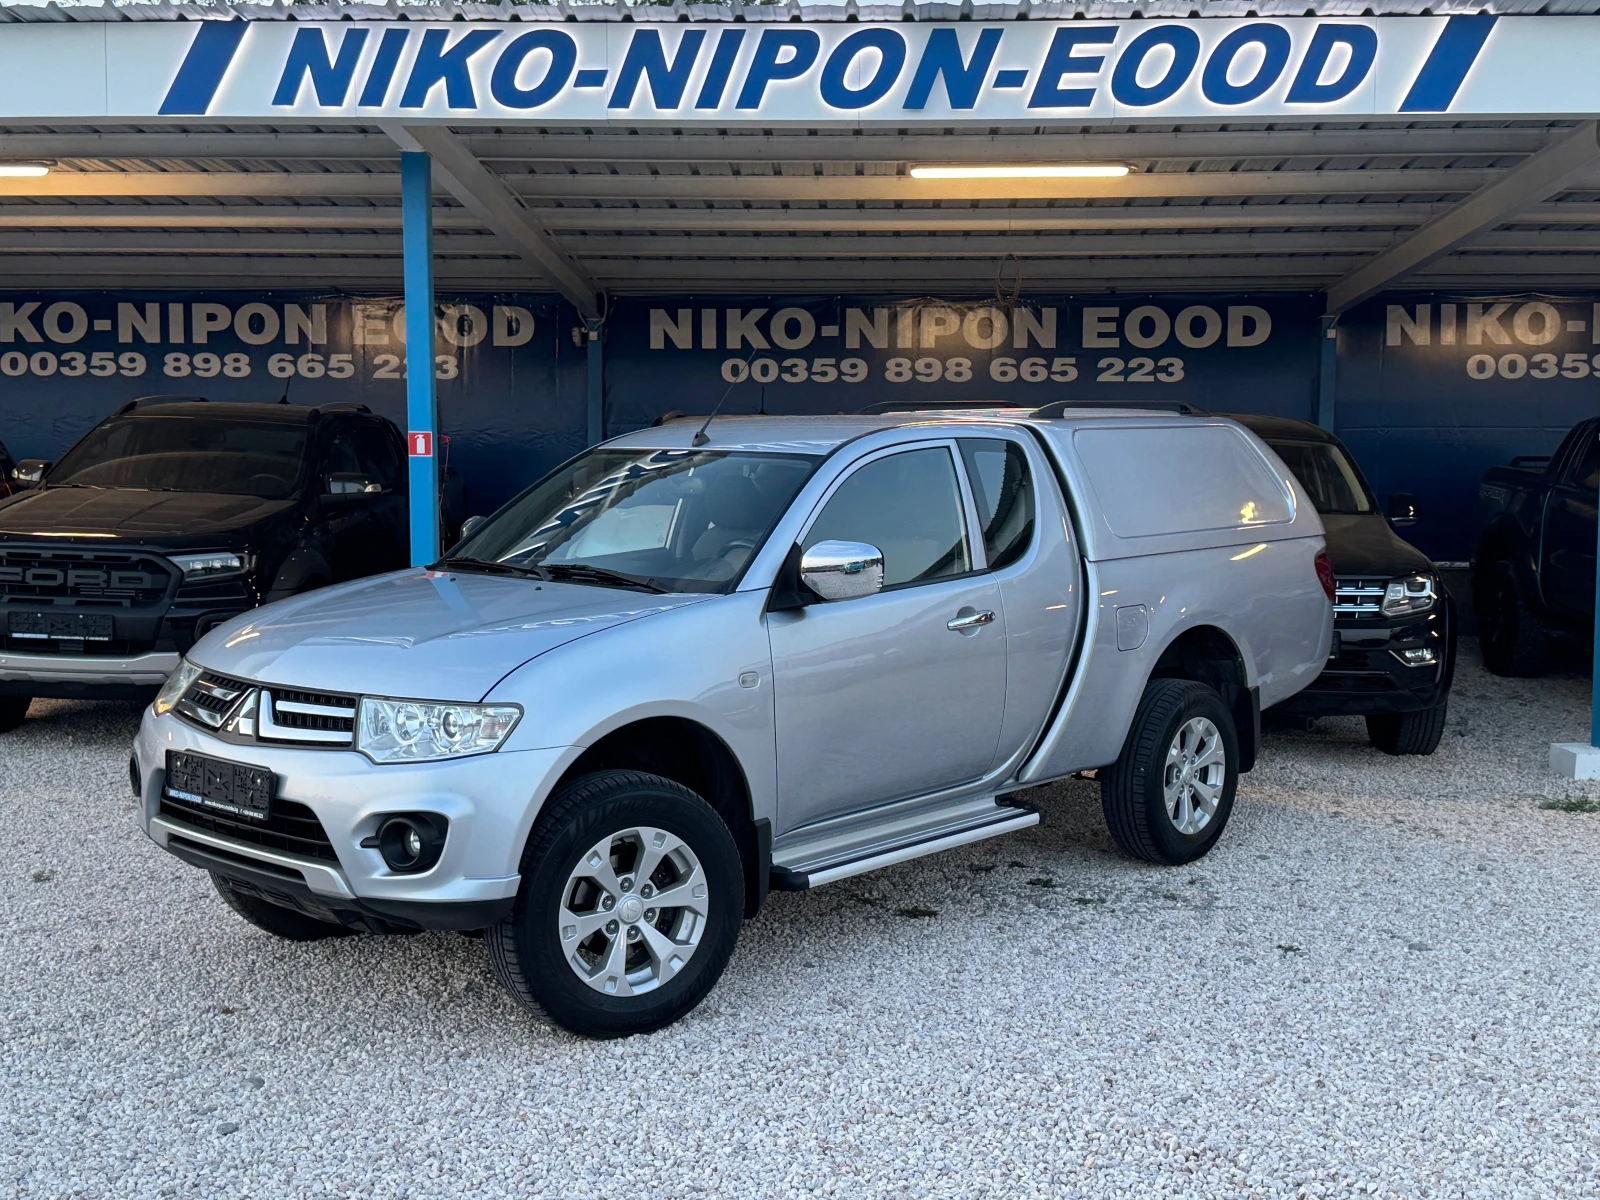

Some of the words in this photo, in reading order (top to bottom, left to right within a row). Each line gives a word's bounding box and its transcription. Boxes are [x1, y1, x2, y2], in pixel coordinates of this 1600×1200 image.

[272, 25, 1377, 109] NIKO-NIPON-EOOD
[649, 305, 1058, 350] NIKO-NIPON
[1082, 305, 1272, 349] EOOD
[1386, 301, 1600, 346] NIKO-
[1, 352, 147, 377] 00359
[163, 353, 252, 378] 898
[268, 353, 355, 378] 665
[372, 353, 459, 379] 23
[721, 358, 868, 383] 00359
[885, 357, 973, 383] 898
[989, 357, 1079, 383] 665
[1097, 357, 1185, 382] 223
[1466, 352, 1600, 379] 0035
